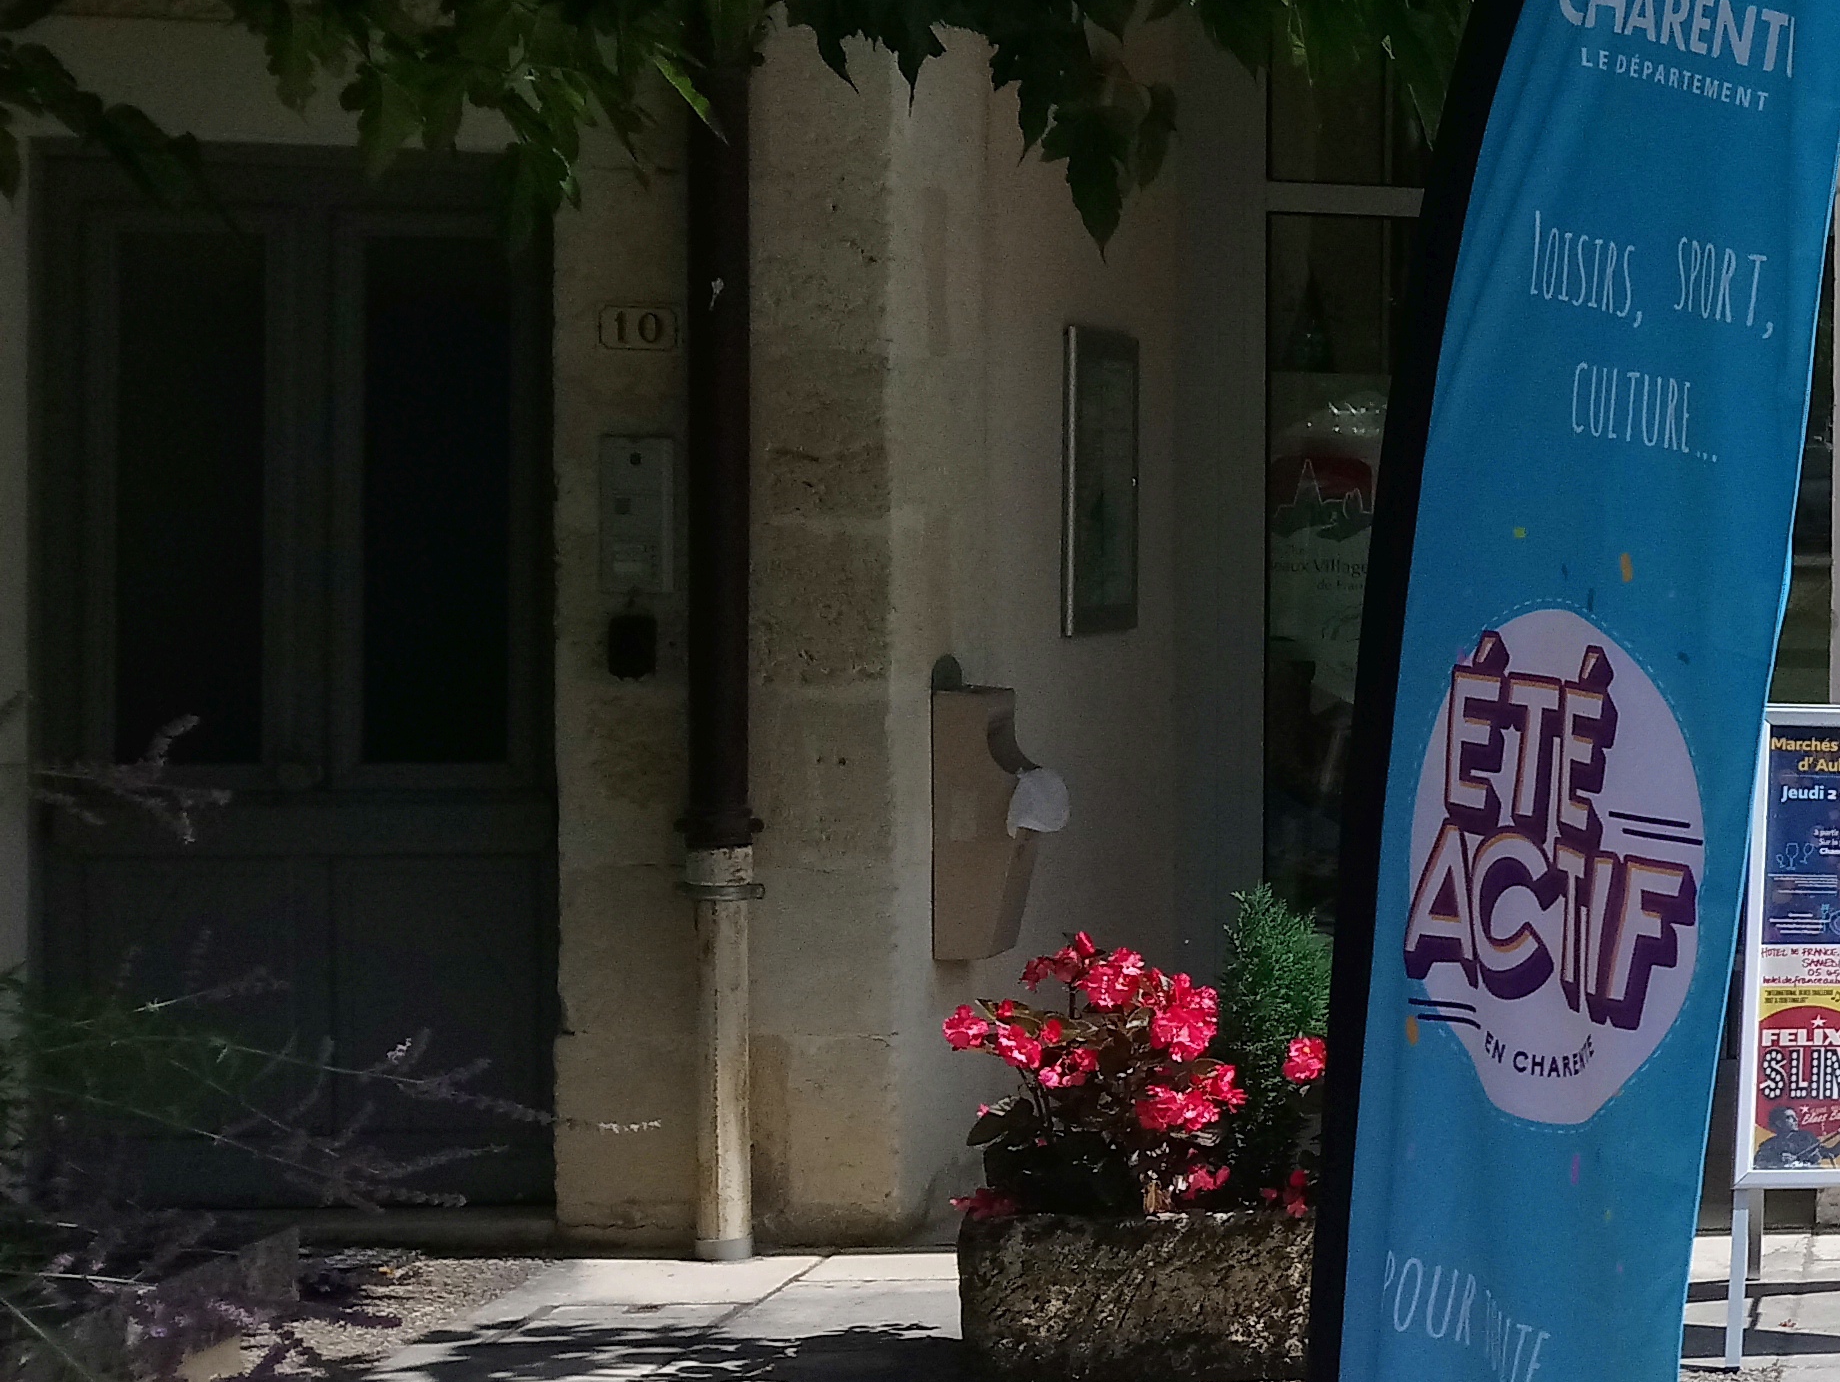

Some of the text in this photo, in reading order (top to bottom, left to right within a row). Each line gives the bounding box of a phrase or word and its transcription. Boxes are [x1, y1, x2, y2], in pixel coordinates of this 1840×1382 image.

[1581, 47, 1768, 112] LE DÉPARTEMENT
[1530, 210, 1774, 339] LOISIRS, SPORT,
[614, 310, 664, 344] 10
[1444, 631, 1618, 845] ÉTÉ
[1771, 737, 1838, 751] Marchés
[1781, 785, 1824, 802] Jeudi
[1827, 790, 1837, 799] 2
[1404, 818, 1696, 1031] ACTIF
[1761, 948, 1788, 958] HOTEL
[1802, 958, 1840, 968] SAMEDI
[1808, 968, 1821, 976] 05
[1484, 1031, 1596, 1078] EN CHARENTE
[1382, 1250, 1476, 1347] POUR
